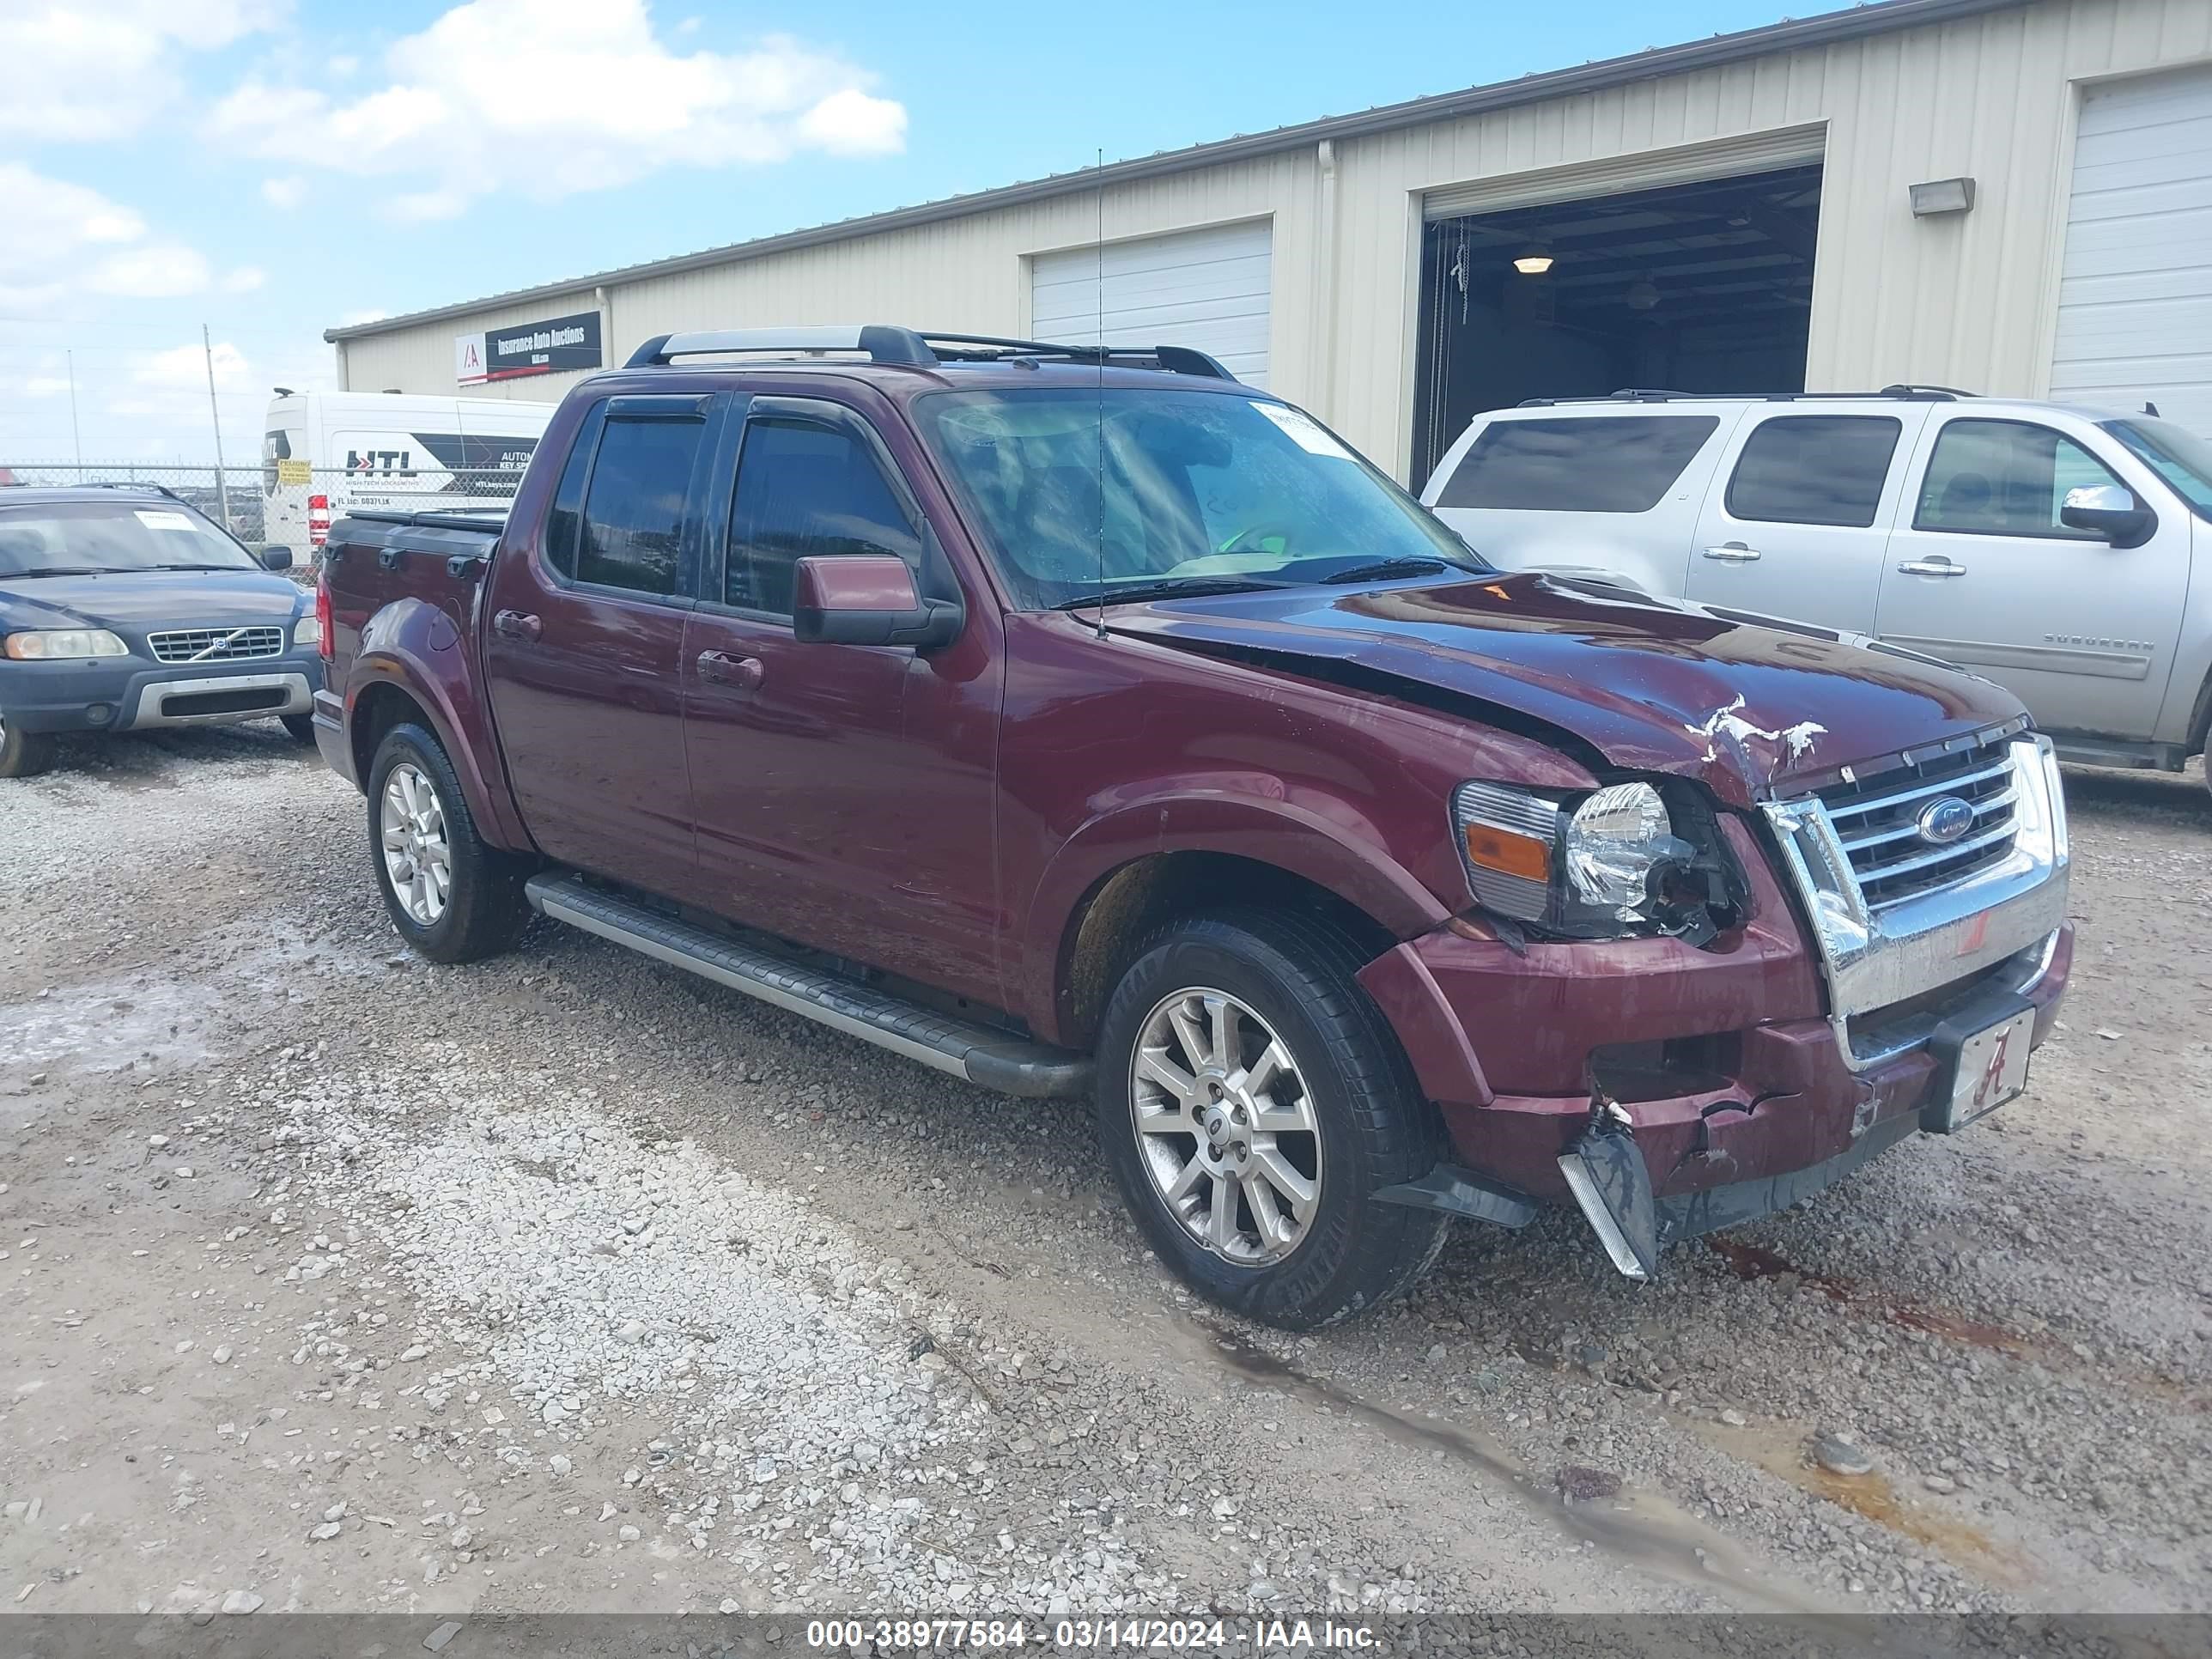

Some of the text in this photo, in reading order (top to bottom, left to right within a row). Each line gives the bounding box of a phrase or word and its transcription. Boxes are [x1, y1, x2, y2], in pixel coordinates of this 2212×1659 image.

[498, 326, 585, 356] Insurance Auto Auctions
[345, 450, 417, 477] HTL
[2043, 633, 2154, 651] SUBURBAN
[1942, 807, 1967, 834] Ford
